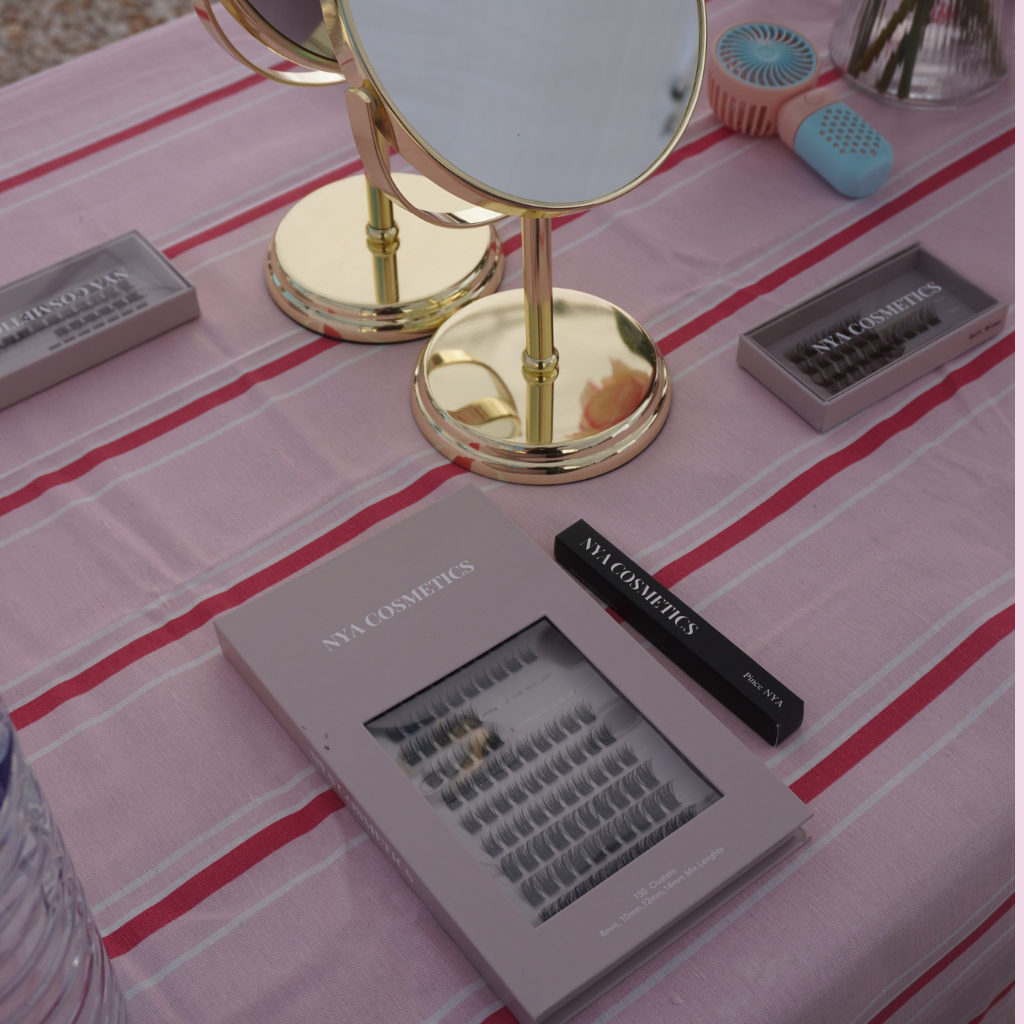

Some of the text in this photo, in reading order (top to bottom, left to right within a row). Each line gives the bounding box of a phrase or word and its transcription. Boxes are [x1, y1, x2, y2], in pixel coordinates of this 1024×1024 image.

[0, 267, 130, 333] NYA COSMETI
[811, 281, 943, 355] NYA COSMETICS
[321, 560, 475, 652] NYA COSMETICS
[580, 537, 611, 566] NYA
[610, 561, 699, 636] COSMETICS
[743, 671, 784, 708] Pince NYA
[600, 921, 621, 937] 8mm,
[684, 866, 699, 876] Mix
[697, 847, 724, 868] Lenghts
[633, 868, 677, 900] 150 Clusters
